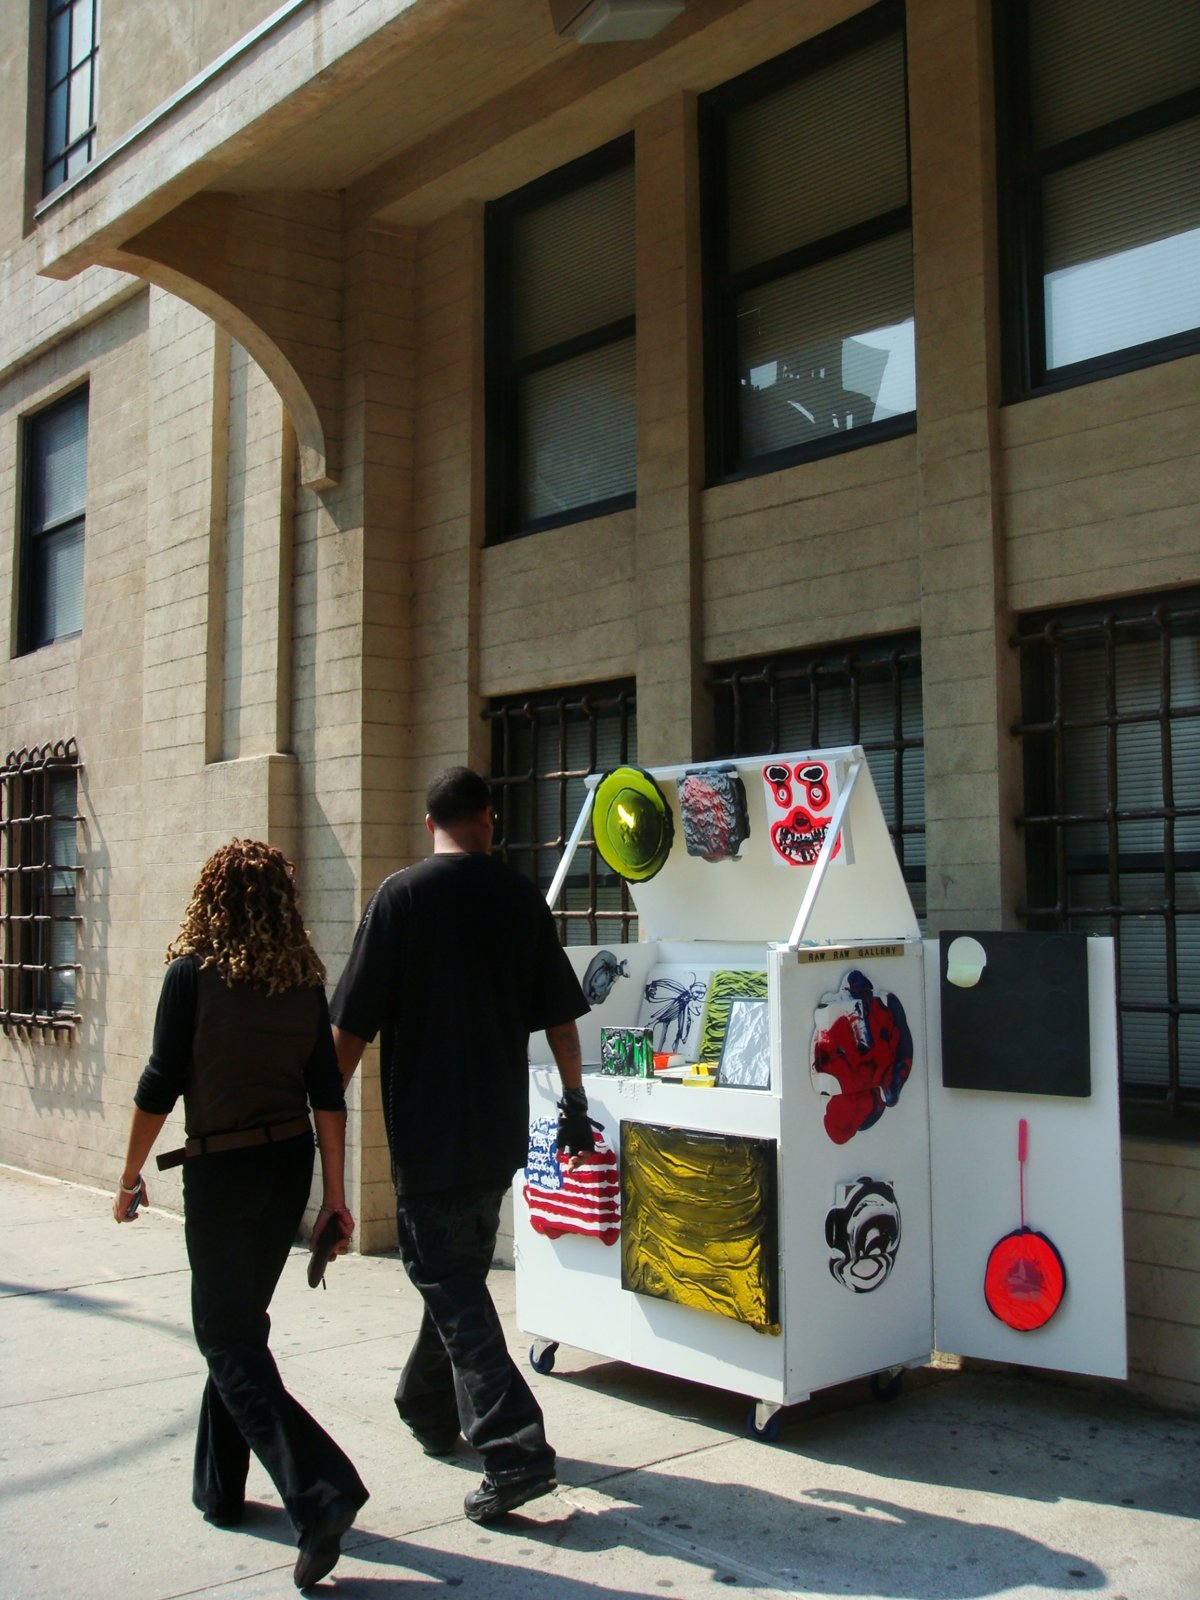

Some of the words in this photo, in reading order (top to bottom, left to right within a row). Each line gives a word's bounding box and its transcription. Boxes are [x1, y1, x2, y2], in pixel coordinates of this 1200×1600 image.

[808, 952, 825, 961] RAW
[833, 950, 850, 959] RAW
[858, 946, 896, 957] GALLERY
